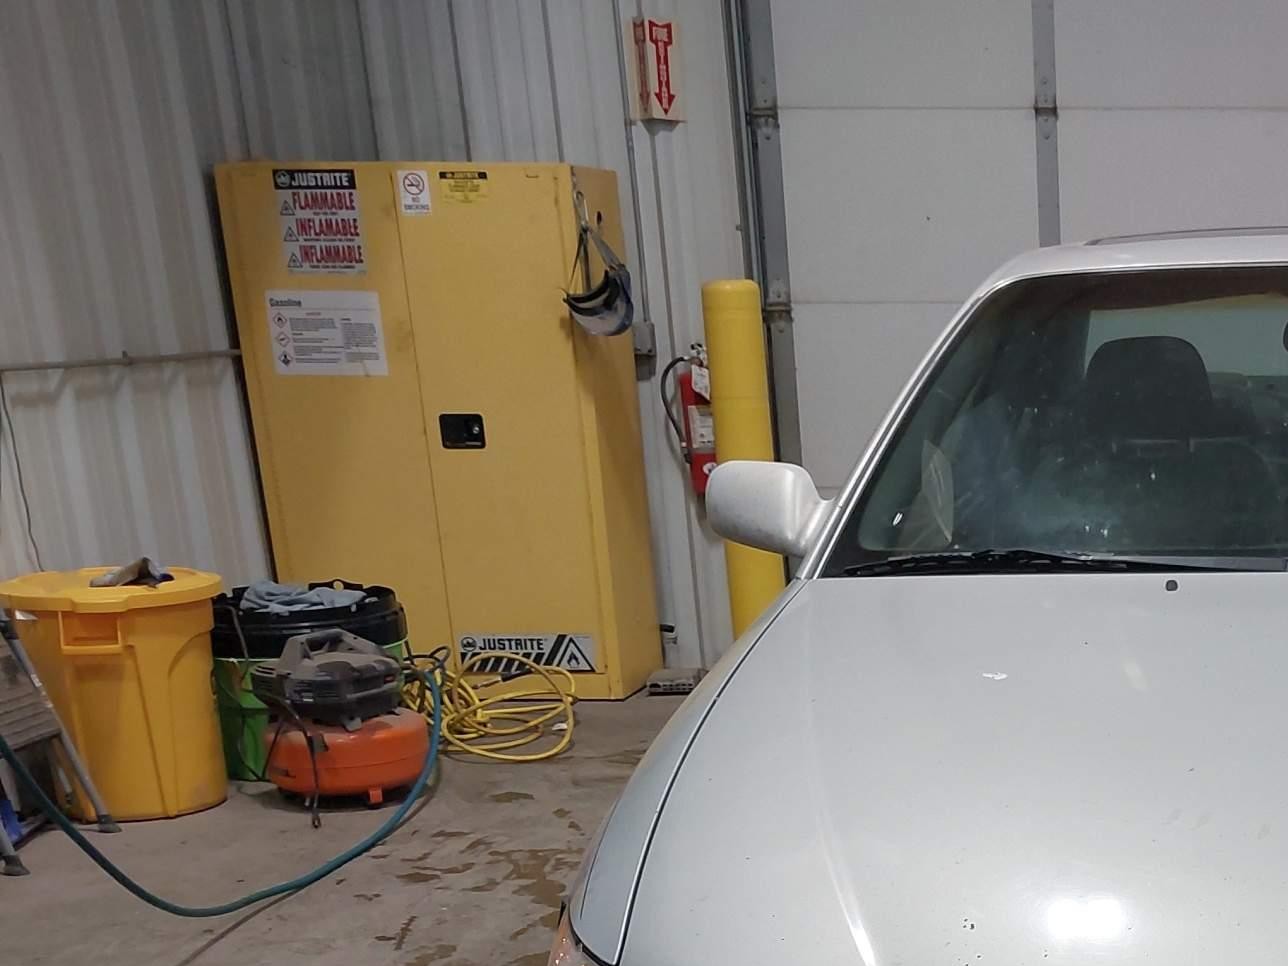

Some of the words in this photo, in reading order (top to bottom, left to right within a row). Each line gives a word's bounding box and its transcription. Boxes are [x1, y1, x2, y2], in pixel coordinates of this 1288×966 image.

[291, 172, 350, 186] JUSTRITE
[292, 191, 356, 210] FLAMMABLE
[296, 218, 360, 237] INFLAMABLE
[299, 245, 364, 263] INFLAMMABLE
[478, 637, 545, 651] JUSTRITE
